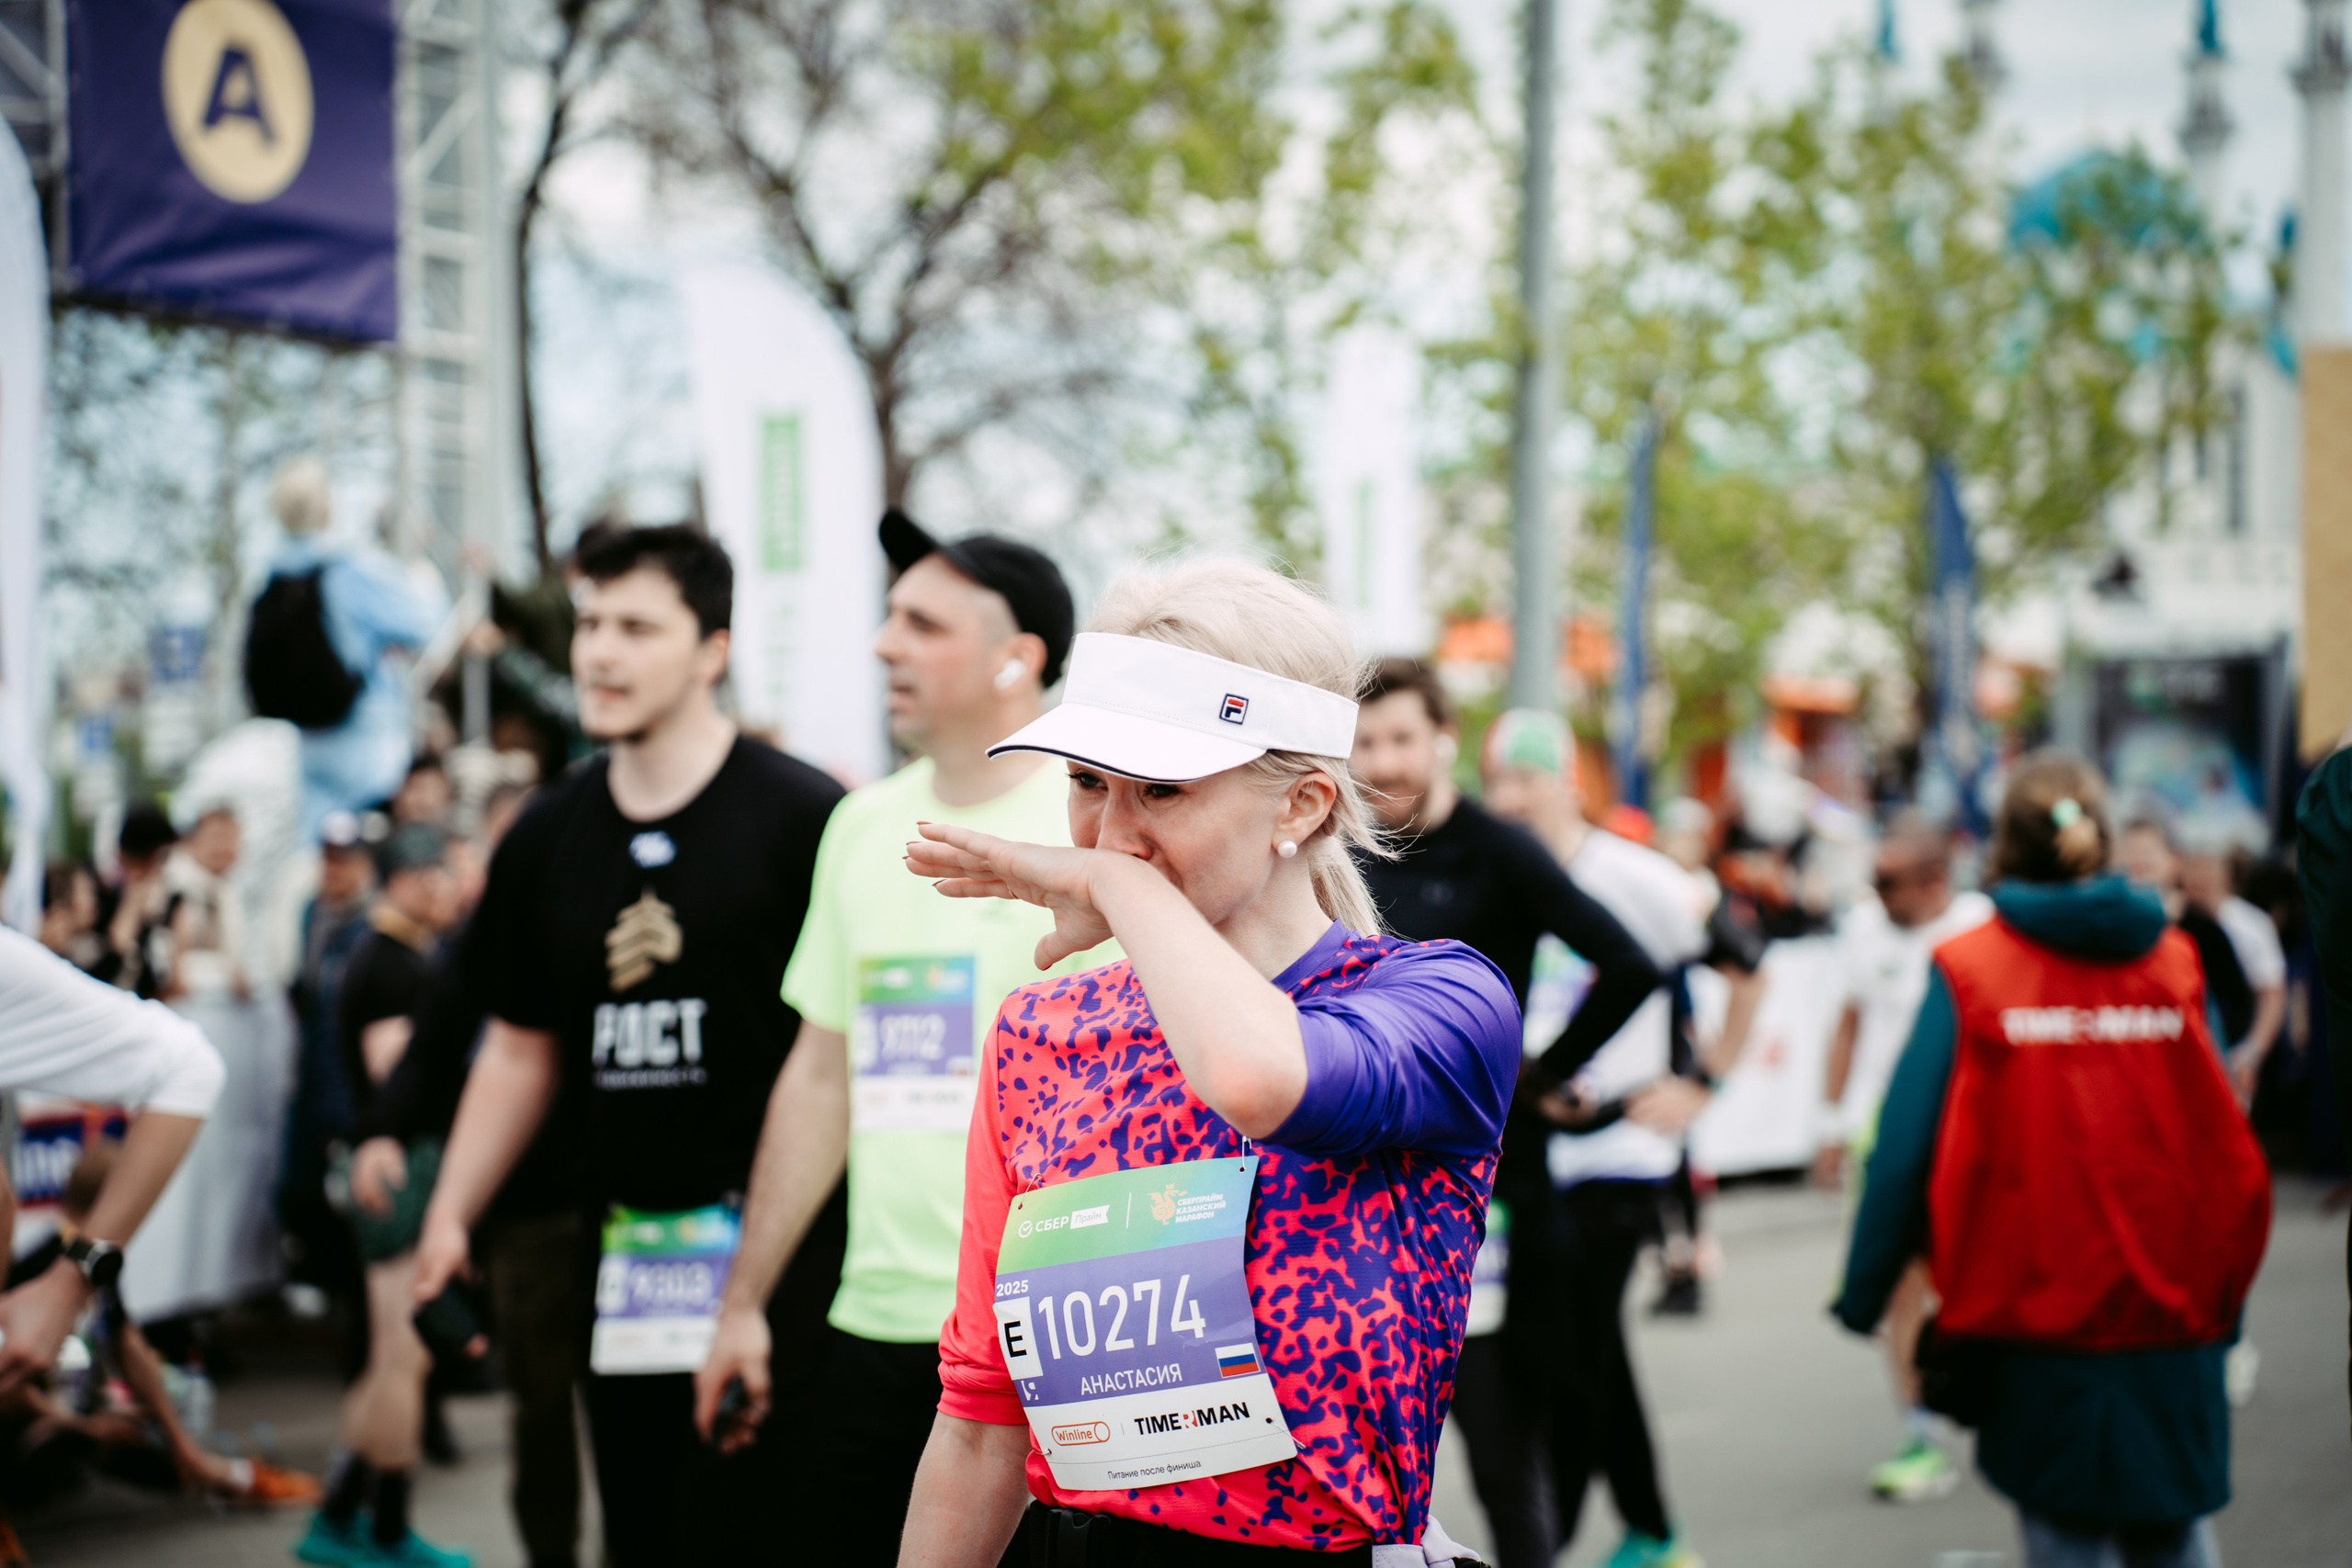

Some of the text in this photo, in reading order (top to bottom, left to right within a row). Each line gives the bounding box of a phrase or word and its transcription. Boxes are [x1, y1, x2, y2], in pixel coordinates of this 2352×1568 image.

[1176, 1200, 1227, 1215] КАЗАНСКИЙ
[1177, 1192, 1224, 1206] СБЕРПРАЙМ
[1035, 1212, 1102, 1233] СБЕР Прайм
[1175, 1211, 1215, 1224] МАРАФОН
[996, 1280, 1029, 1297] 2025
[1003, 1274, 1206, 1360] E 10274
[1080, 1363, 1183, 1396] АНАСТАСИЯ
[1055, 1427, 1093, 1442] Winline
[1107, 1461, 1202, 1481] Питание после финиша
